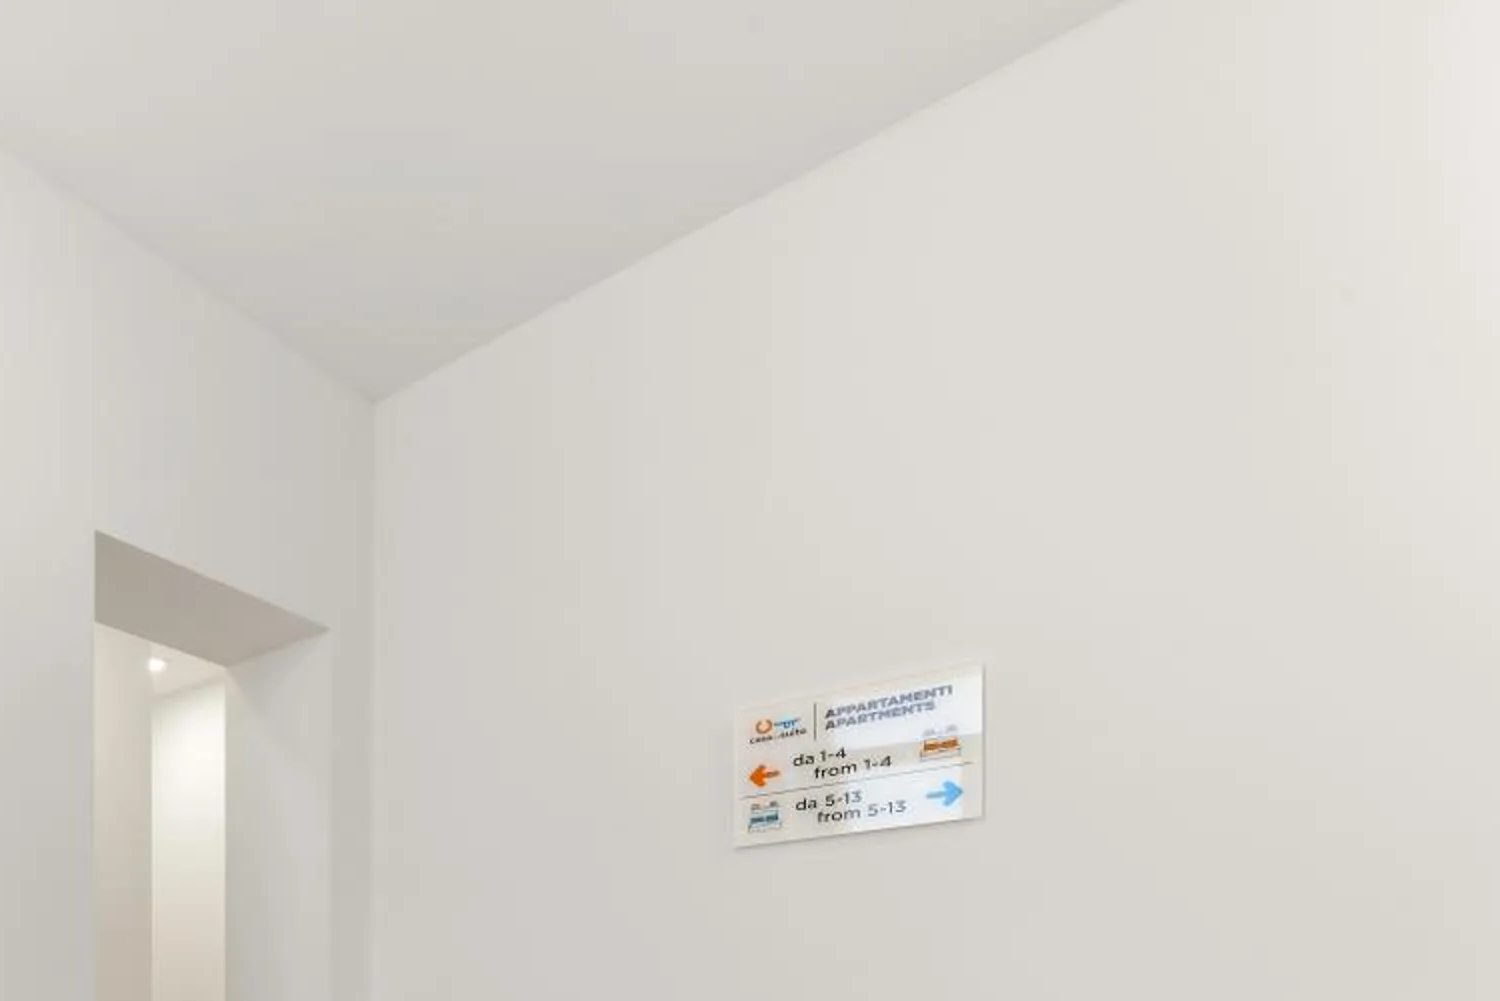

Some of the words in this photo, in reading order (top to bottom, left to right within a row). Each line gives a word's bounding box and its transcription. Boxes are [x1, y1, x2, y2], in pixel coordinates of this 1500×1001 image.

[825, 685, 953, 718] APPARTAMENTI
[825, 701, 935, 730] APARTMENTS
[794, 753, 814, 767] da
[820, 747, 846, 762] 1-4
[814, 763, 857, 779] from
[864, 755, 892, 770] 1-4
[795, 798, 817, 811] da
[825, 791, 862, 807] 5-13
[817, 808, 861, 823] from
[867, 800, 907, 817] 5-13
